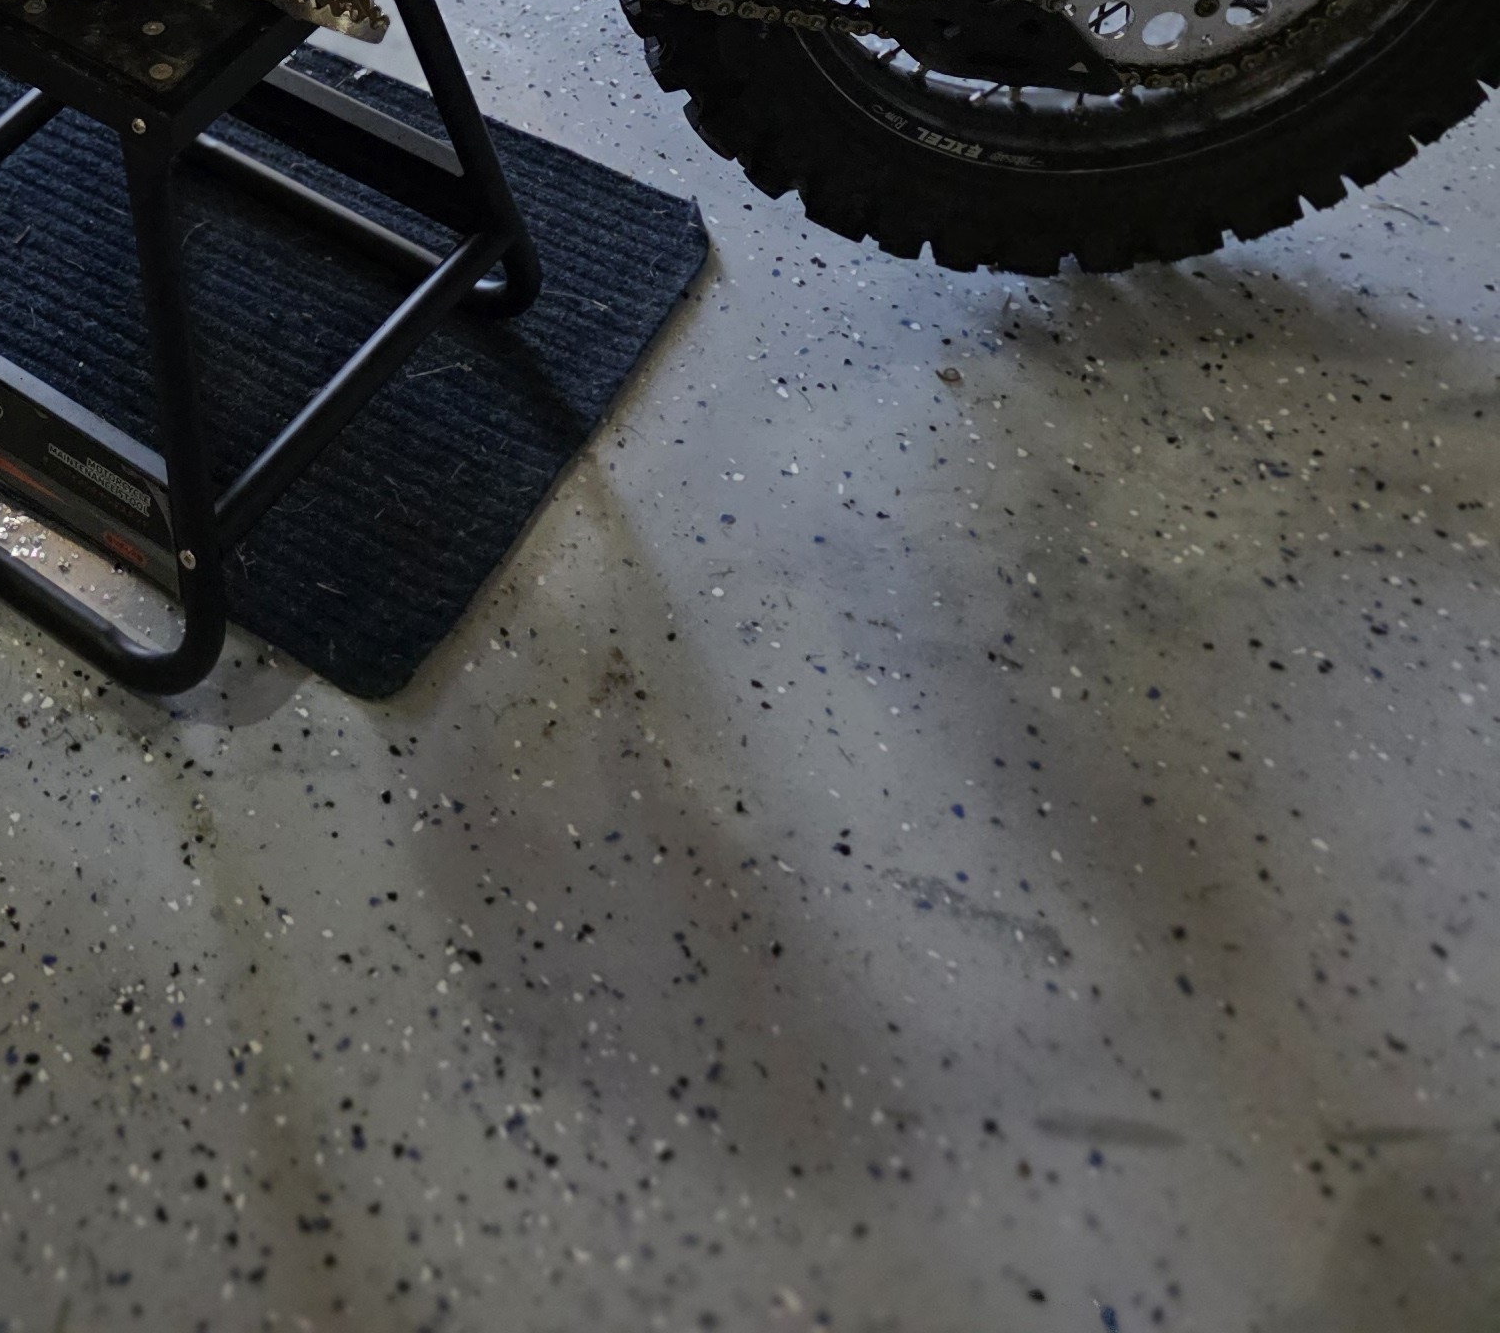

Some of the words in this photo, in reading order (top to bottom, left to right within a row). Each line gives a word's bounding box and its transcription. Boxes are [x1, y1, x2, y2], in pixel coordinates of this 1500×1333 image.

[917, 126, 983, 159] EXCEL
[48, 442, 120, 499] MAINTENANCE
[86, 457, 151, 507] MOTORCYCLE
